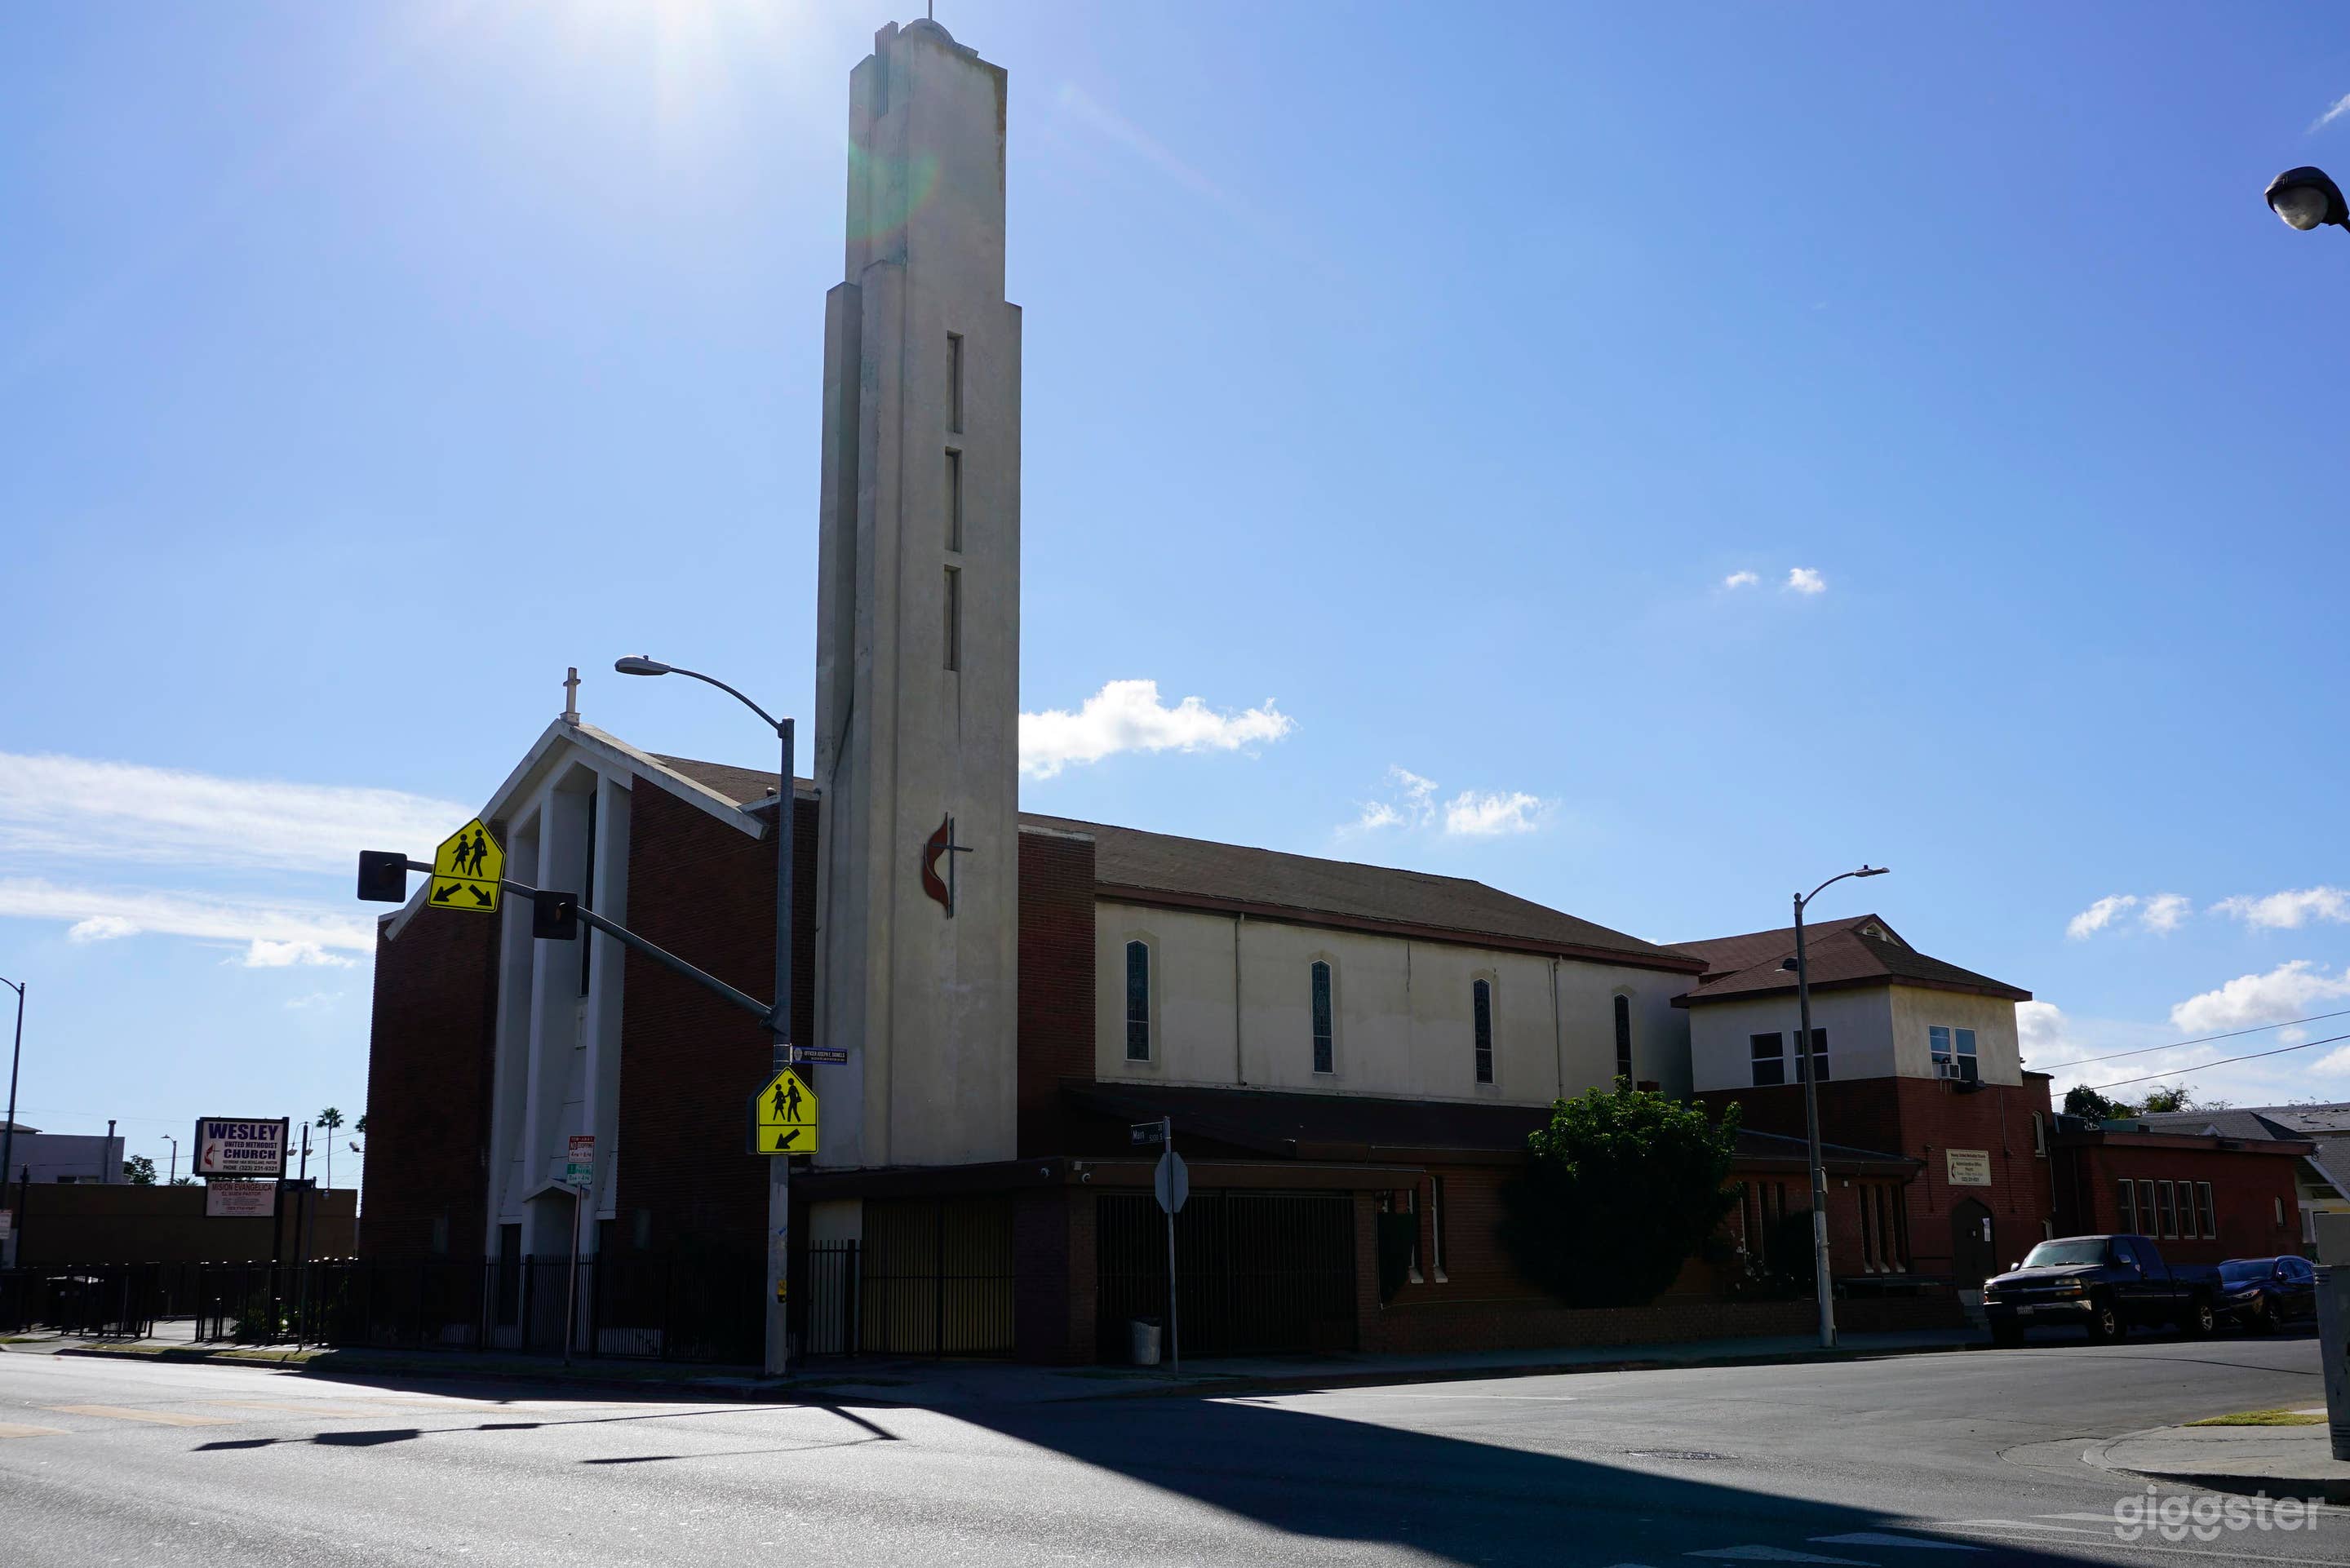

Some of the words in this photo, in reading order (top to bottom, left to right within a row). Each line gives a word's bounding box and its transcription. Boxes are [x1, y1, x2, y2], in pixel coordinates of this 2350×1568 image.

[208, 1123, 278, 1141] WESLEY
[1133, 1129, 1145, 1141] Main
[224, 1149, 276, 1159] CHURCH
